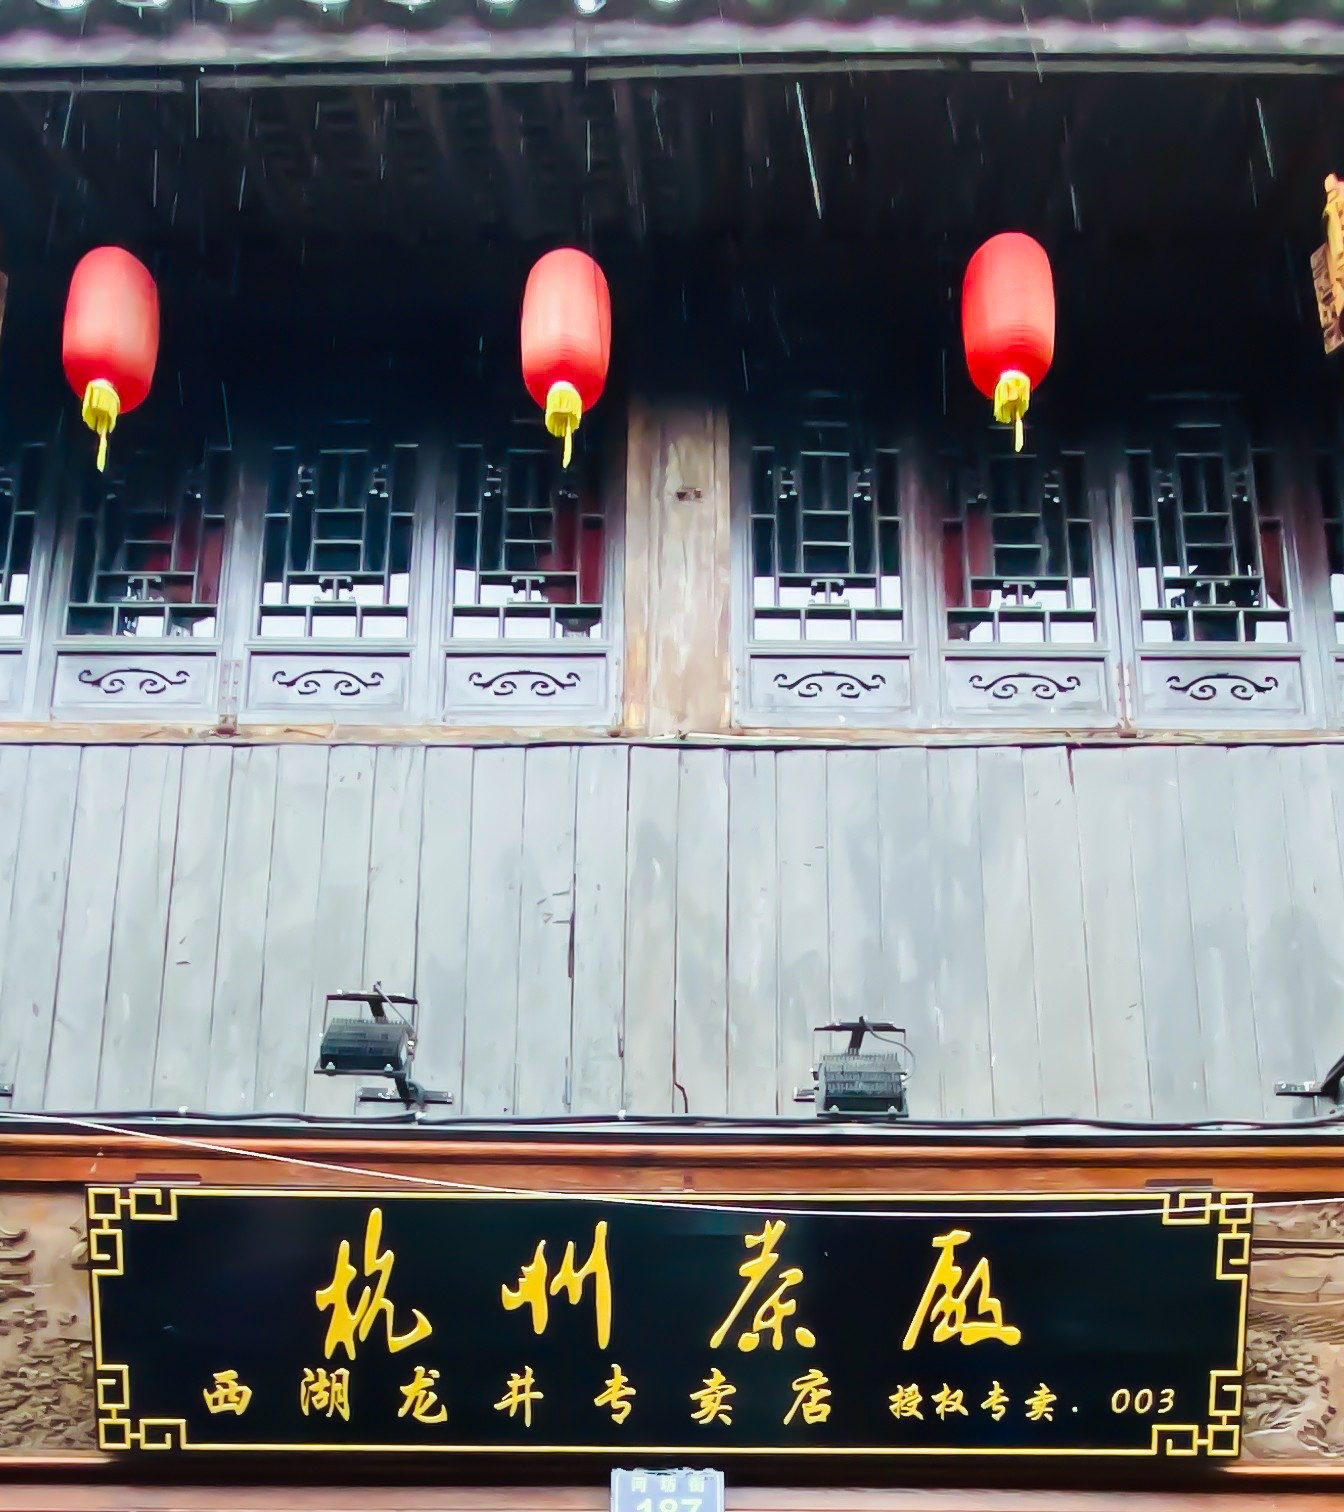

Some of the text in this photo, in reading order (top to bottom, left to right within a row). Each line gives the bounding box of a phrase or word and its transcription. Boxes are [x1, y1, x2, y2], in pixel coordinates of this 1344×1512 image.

[202, 1364, 833, 1427] 西湖龙井专卖店
